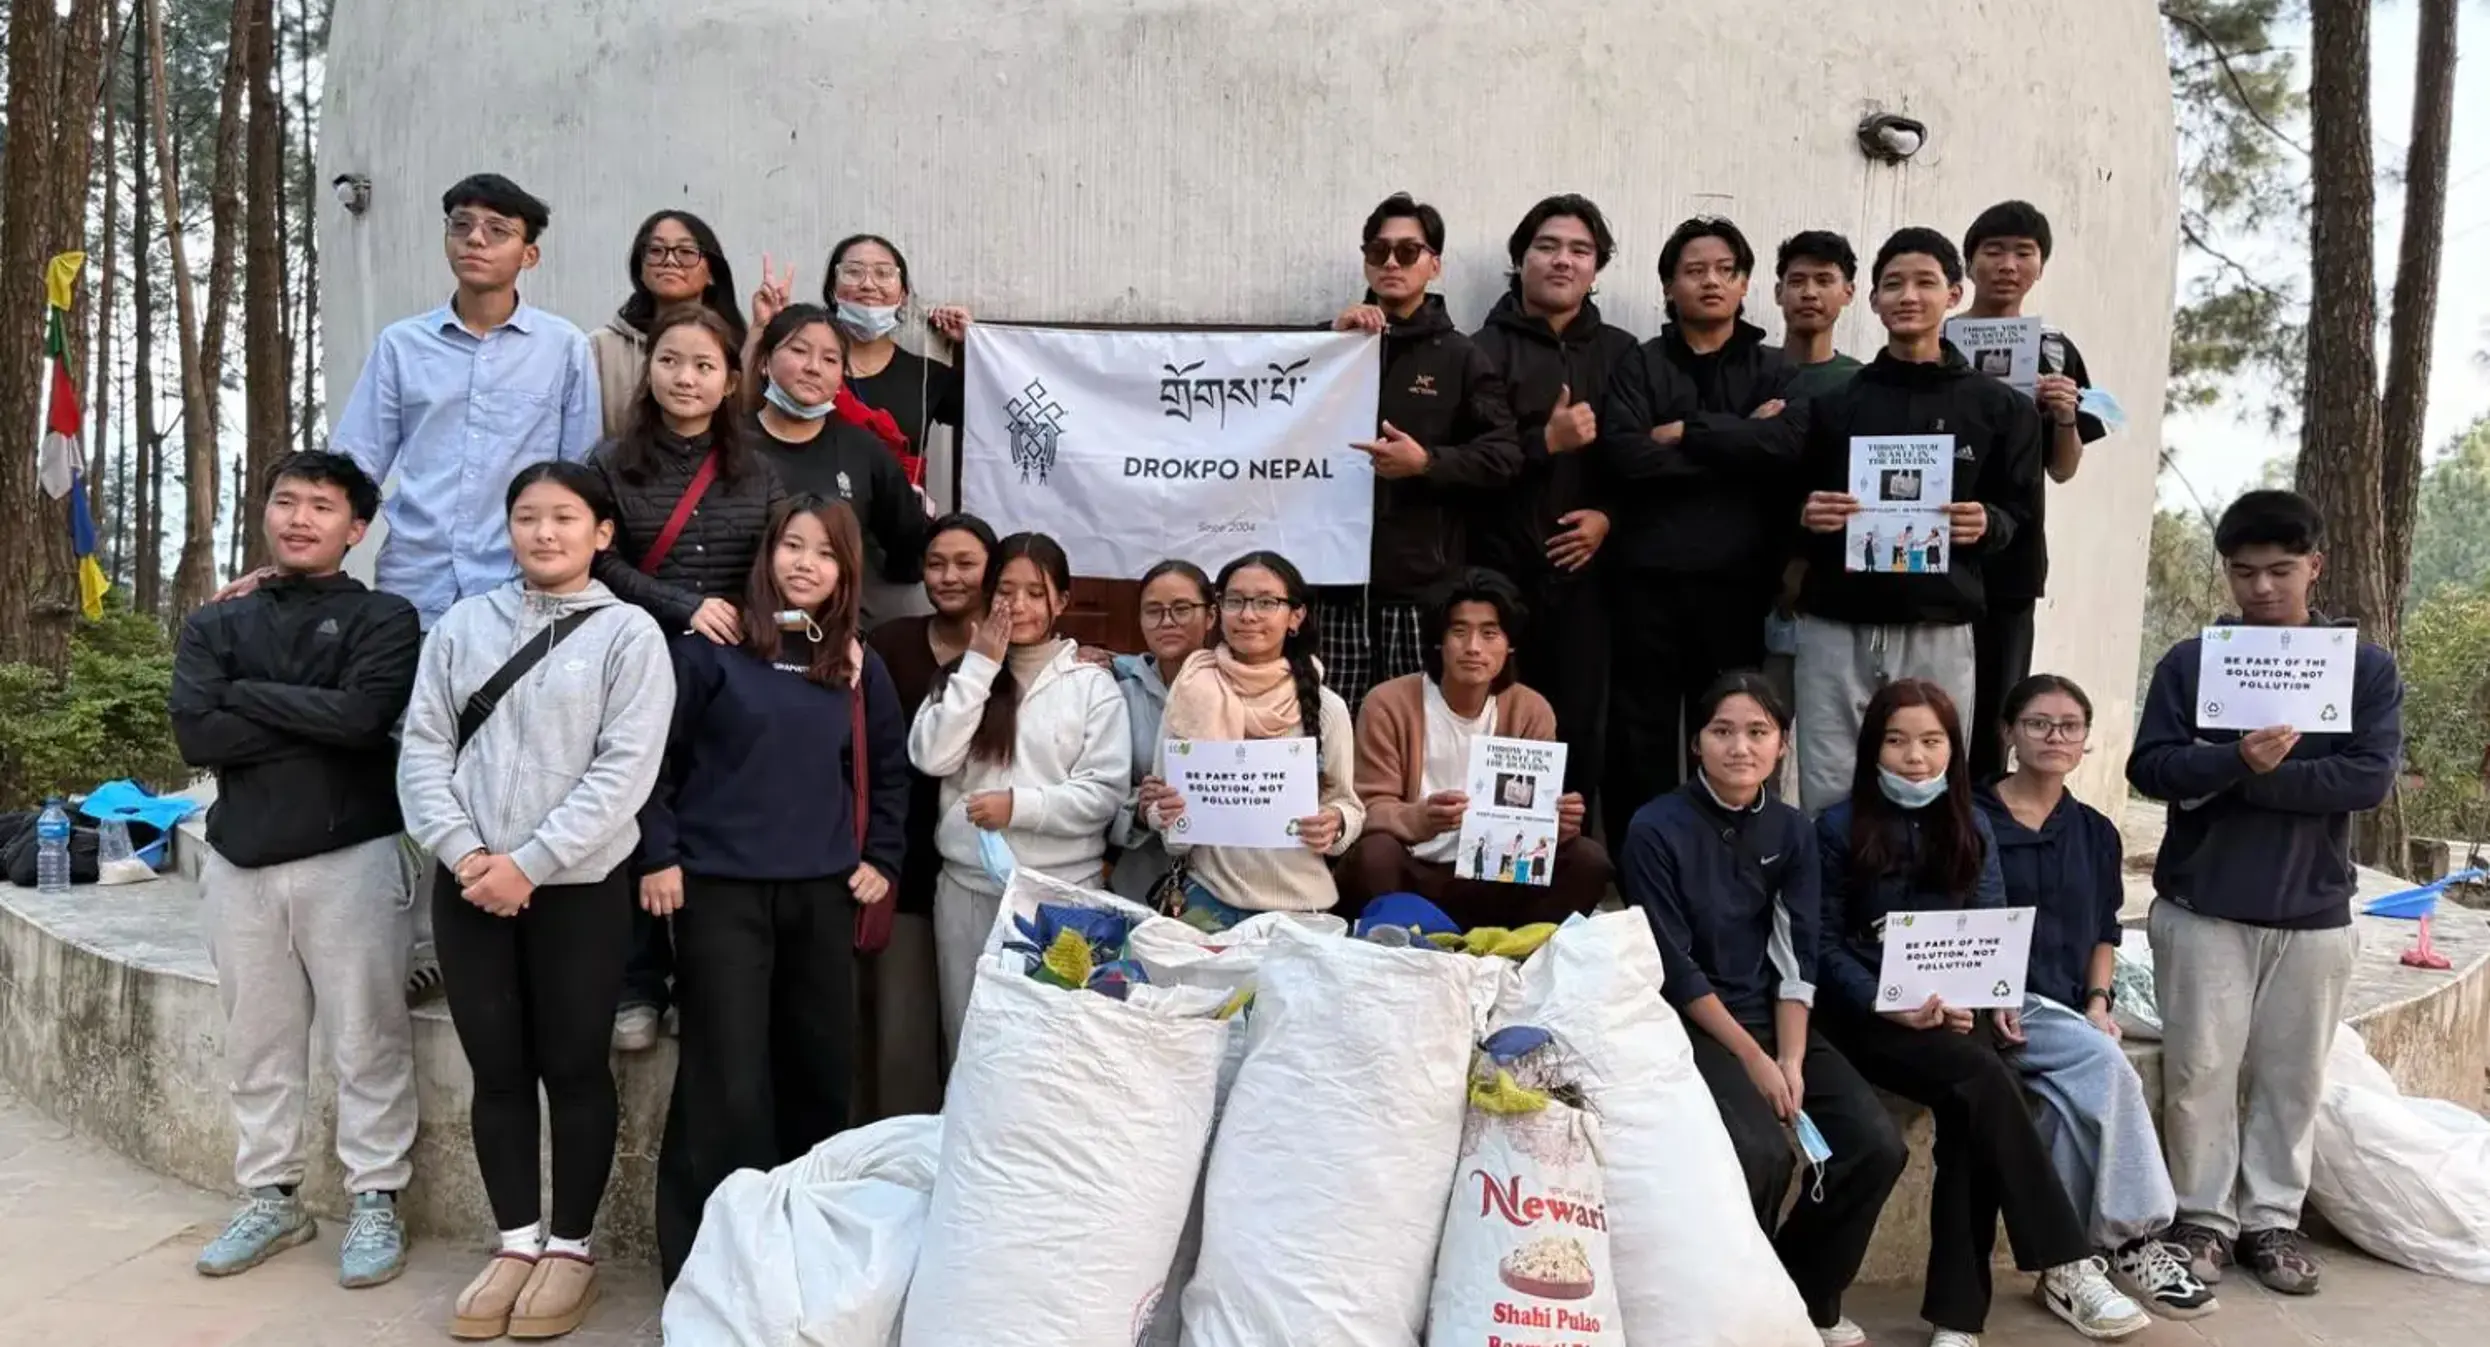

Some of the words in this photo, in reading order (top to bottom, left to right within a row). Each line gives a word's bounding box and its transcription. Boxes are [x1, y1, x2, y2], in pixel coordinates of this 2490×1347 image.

[1124, 457, 1240, 480] DROKPO
[1249, 458, 1334, 480] NEPAL
[2224, 656, 2241, 665] BE
[2246, 657, 2280, 666] PART
[2285, 658, 2300, 667] OF
[2306, 659, 2327, 667] THE
[2226, 669, 2297, 679] SOLUTION,
[2300, 670, 2324, 678] NOT
[2239, 681, 2311, 690] POLLUTION
[1185, 771, 1201, 780] BE
[1206, 771, 1237, 781] PART
[1241, 772, 1257, 781] OF
[1262, 772, 1286, 780] THE
[1188, 784, 1254, 794] SOLUTION,
[1259, 784, 1284, 793] NOT
[1202, 796, 1271, 805] POLLUTION
[1905, 942, 1920, 950] BE
[1924, 939, 1954, 949] PART
[1958, 938, 1974, 947] OF
[1978, 937, 2001, 946] THE
[1906, 950, 1968, 961] SOLUTION,
[1973, 948, 1997, 957] NOT
[1917, 961, 1982, 971] POLLUTION
[1469, 1168, 1607, 1233] Newari
[1493, 1302, 1551, 1328] Shahi
[1556, 1308, 1601, 1333] Pulao
